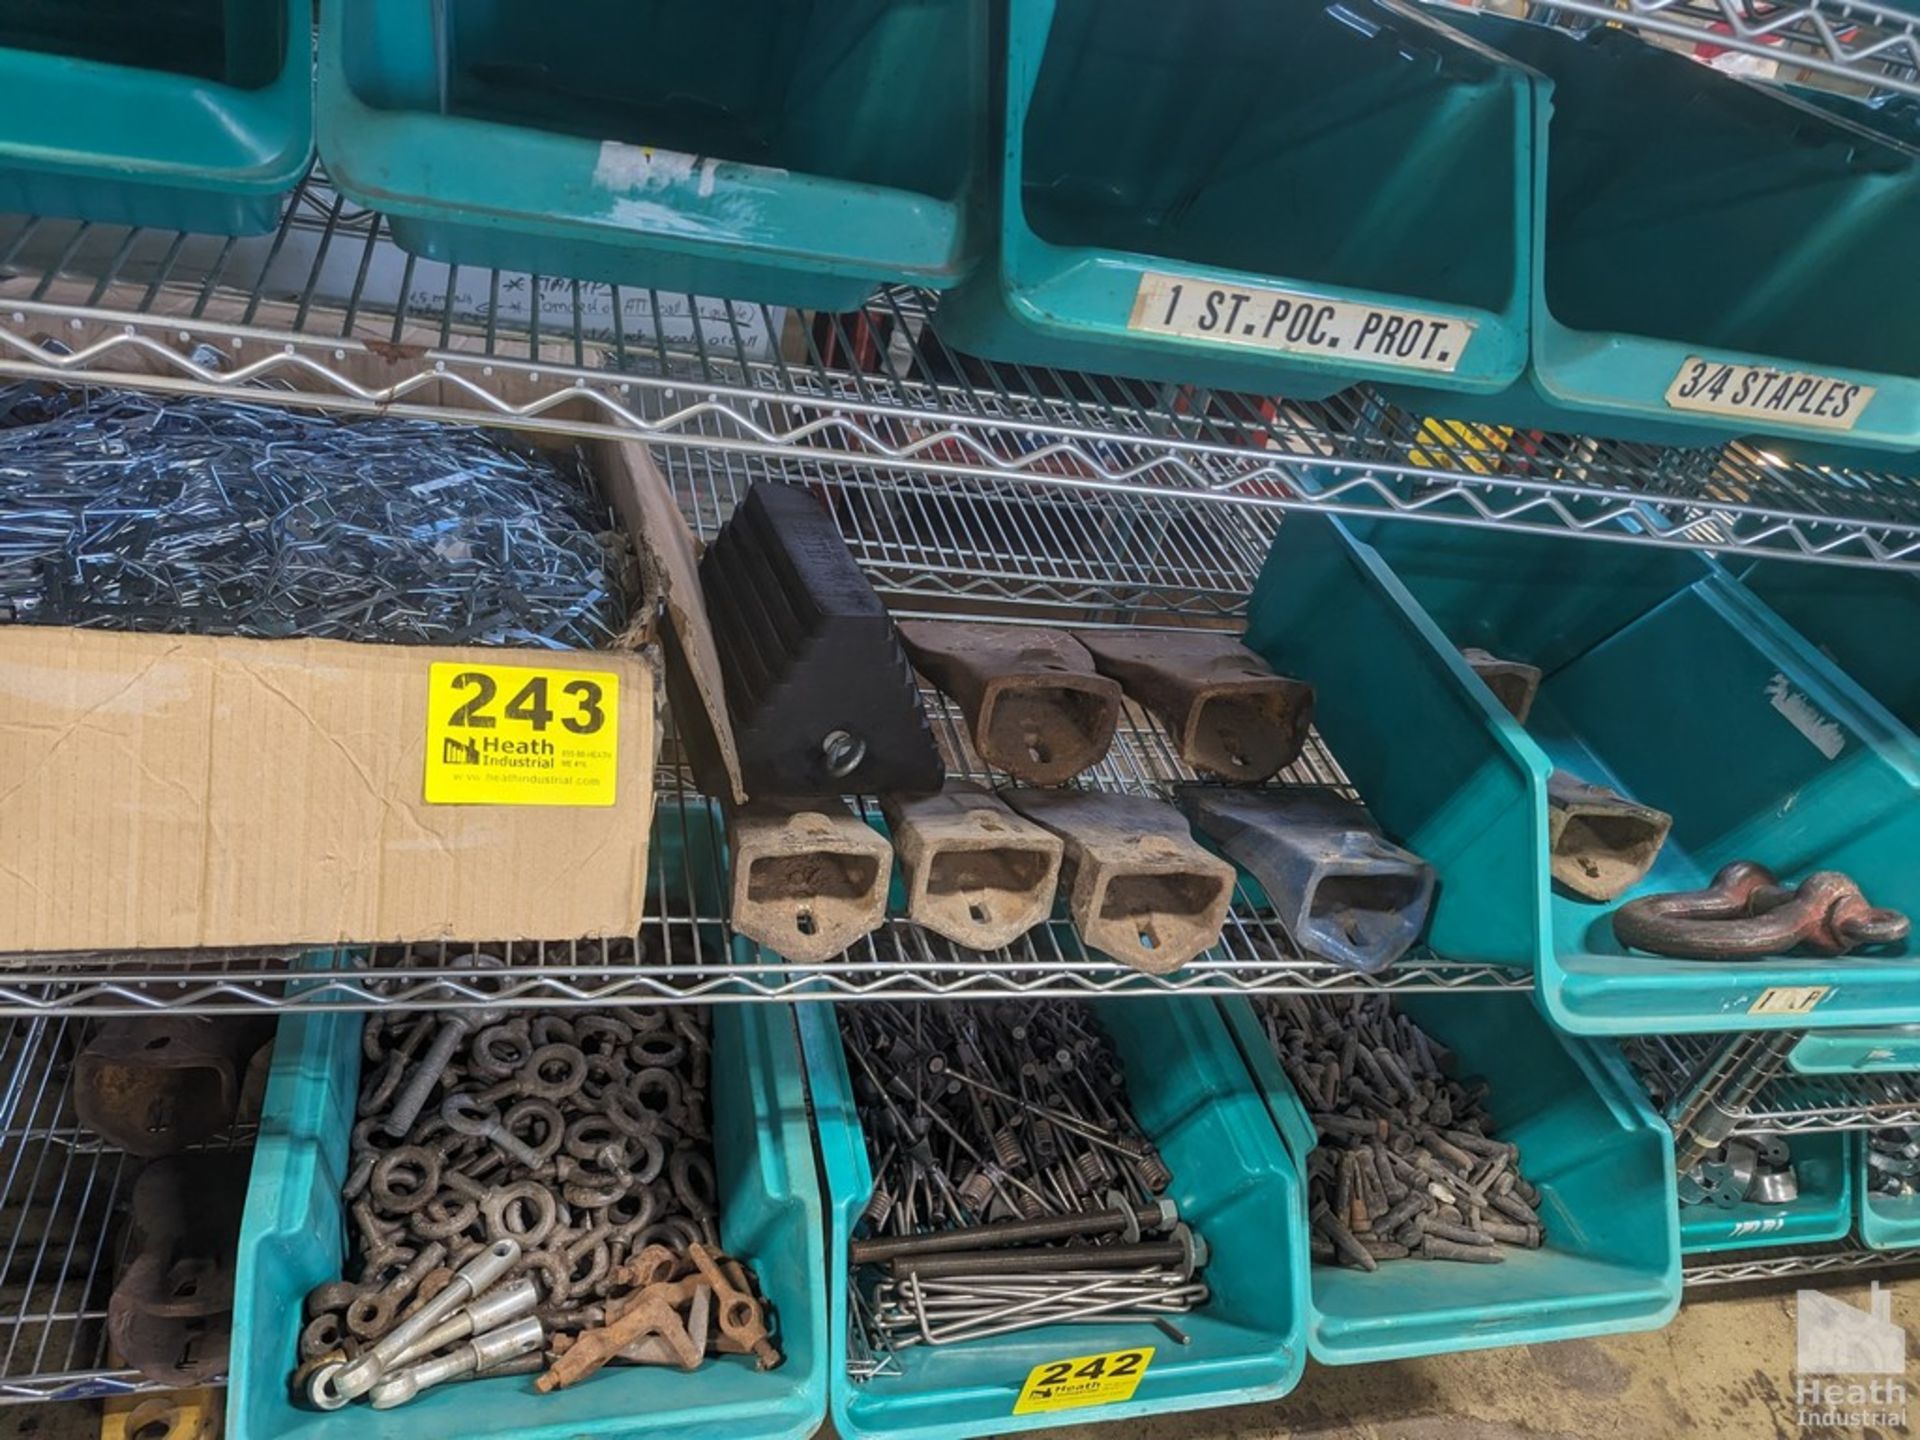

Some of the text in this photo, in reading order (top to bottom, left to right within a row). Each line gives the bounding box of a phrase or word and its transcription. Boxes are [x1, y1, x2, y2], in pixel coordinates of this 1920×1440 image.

[1164, 285, 1183, 325] 1
[1354, 312, 1450, 362] PROT.
[1678, 362, 1860, 417] 3/4 STAPLES
[448, 672, 605, 735] 243
[483, 736, 554, 755] Heath
[483, 755, 554, 769] Industrial
[1037, 1353, 1143, 1387] 242
